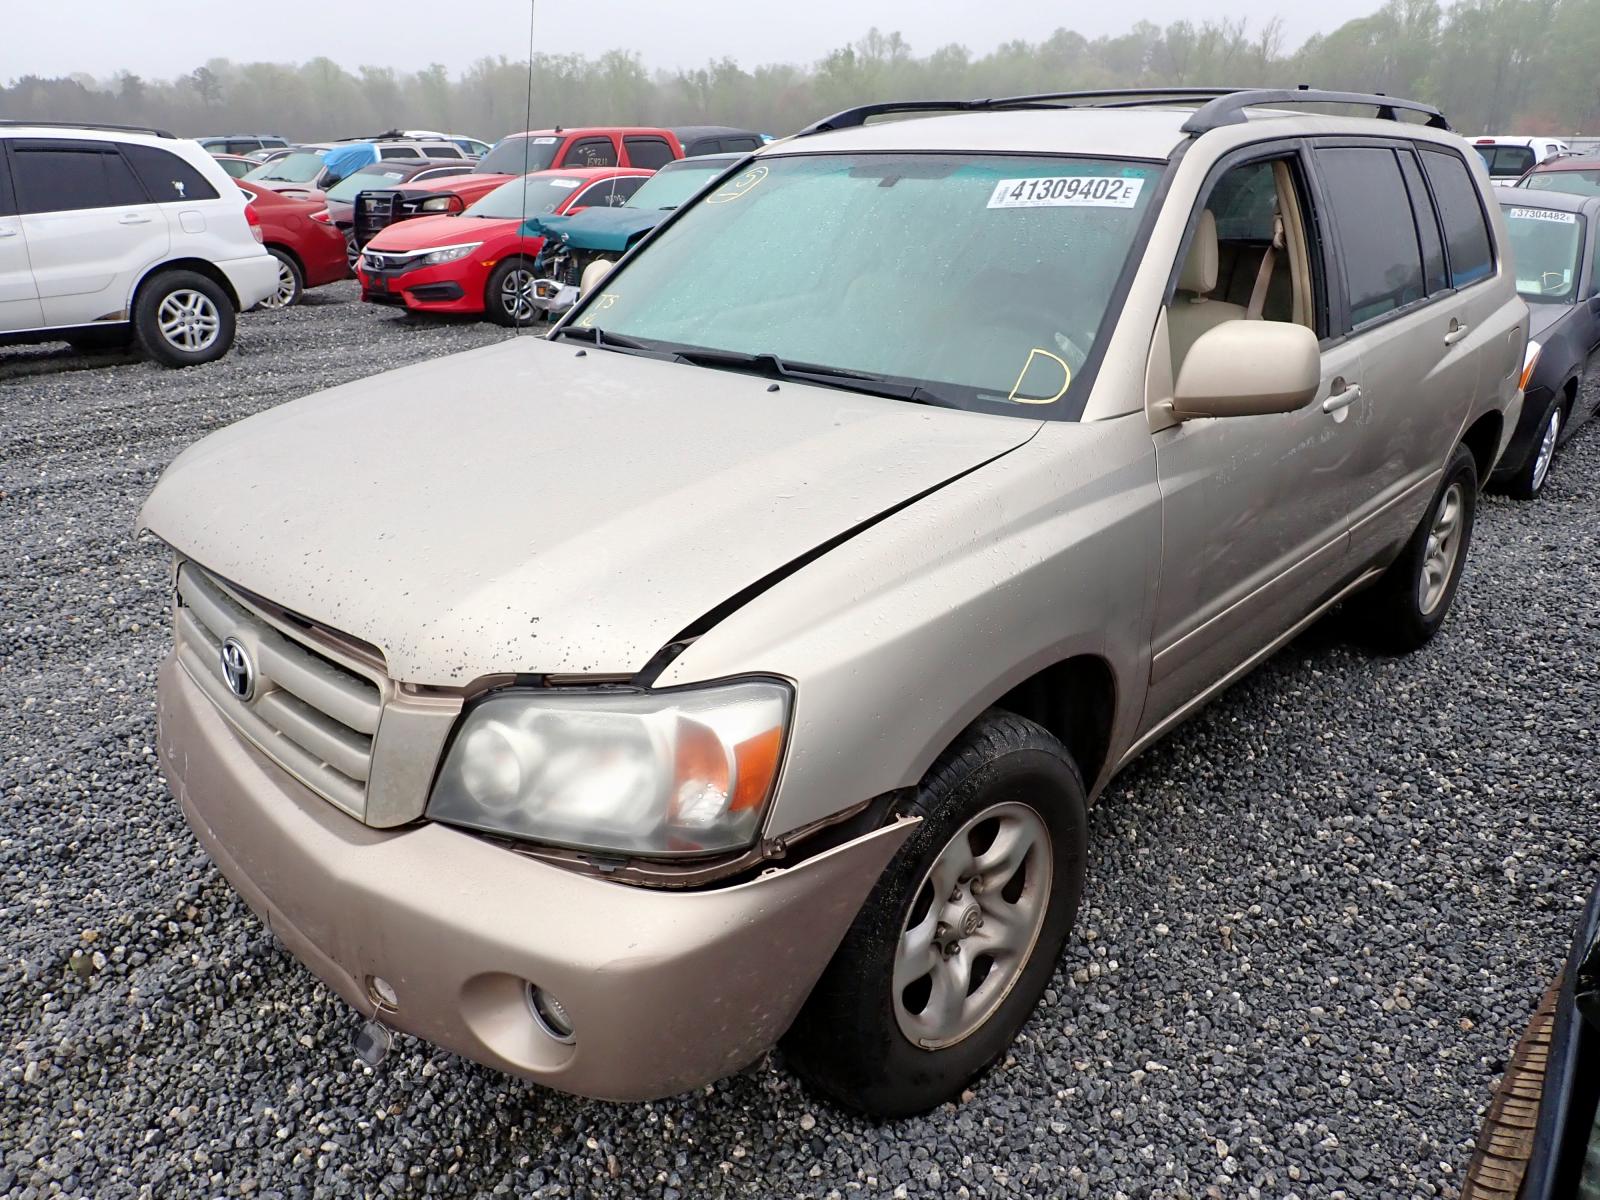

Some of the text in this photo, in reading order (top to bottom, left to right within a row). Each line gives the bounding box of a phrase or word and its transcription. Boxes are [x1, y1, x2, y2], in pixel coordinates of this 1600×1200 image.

[1009, 178, 1124, 200] 41309402
[1517, 209, 1566, 221] 37304482
[1008, 348, 1071, 404] D
